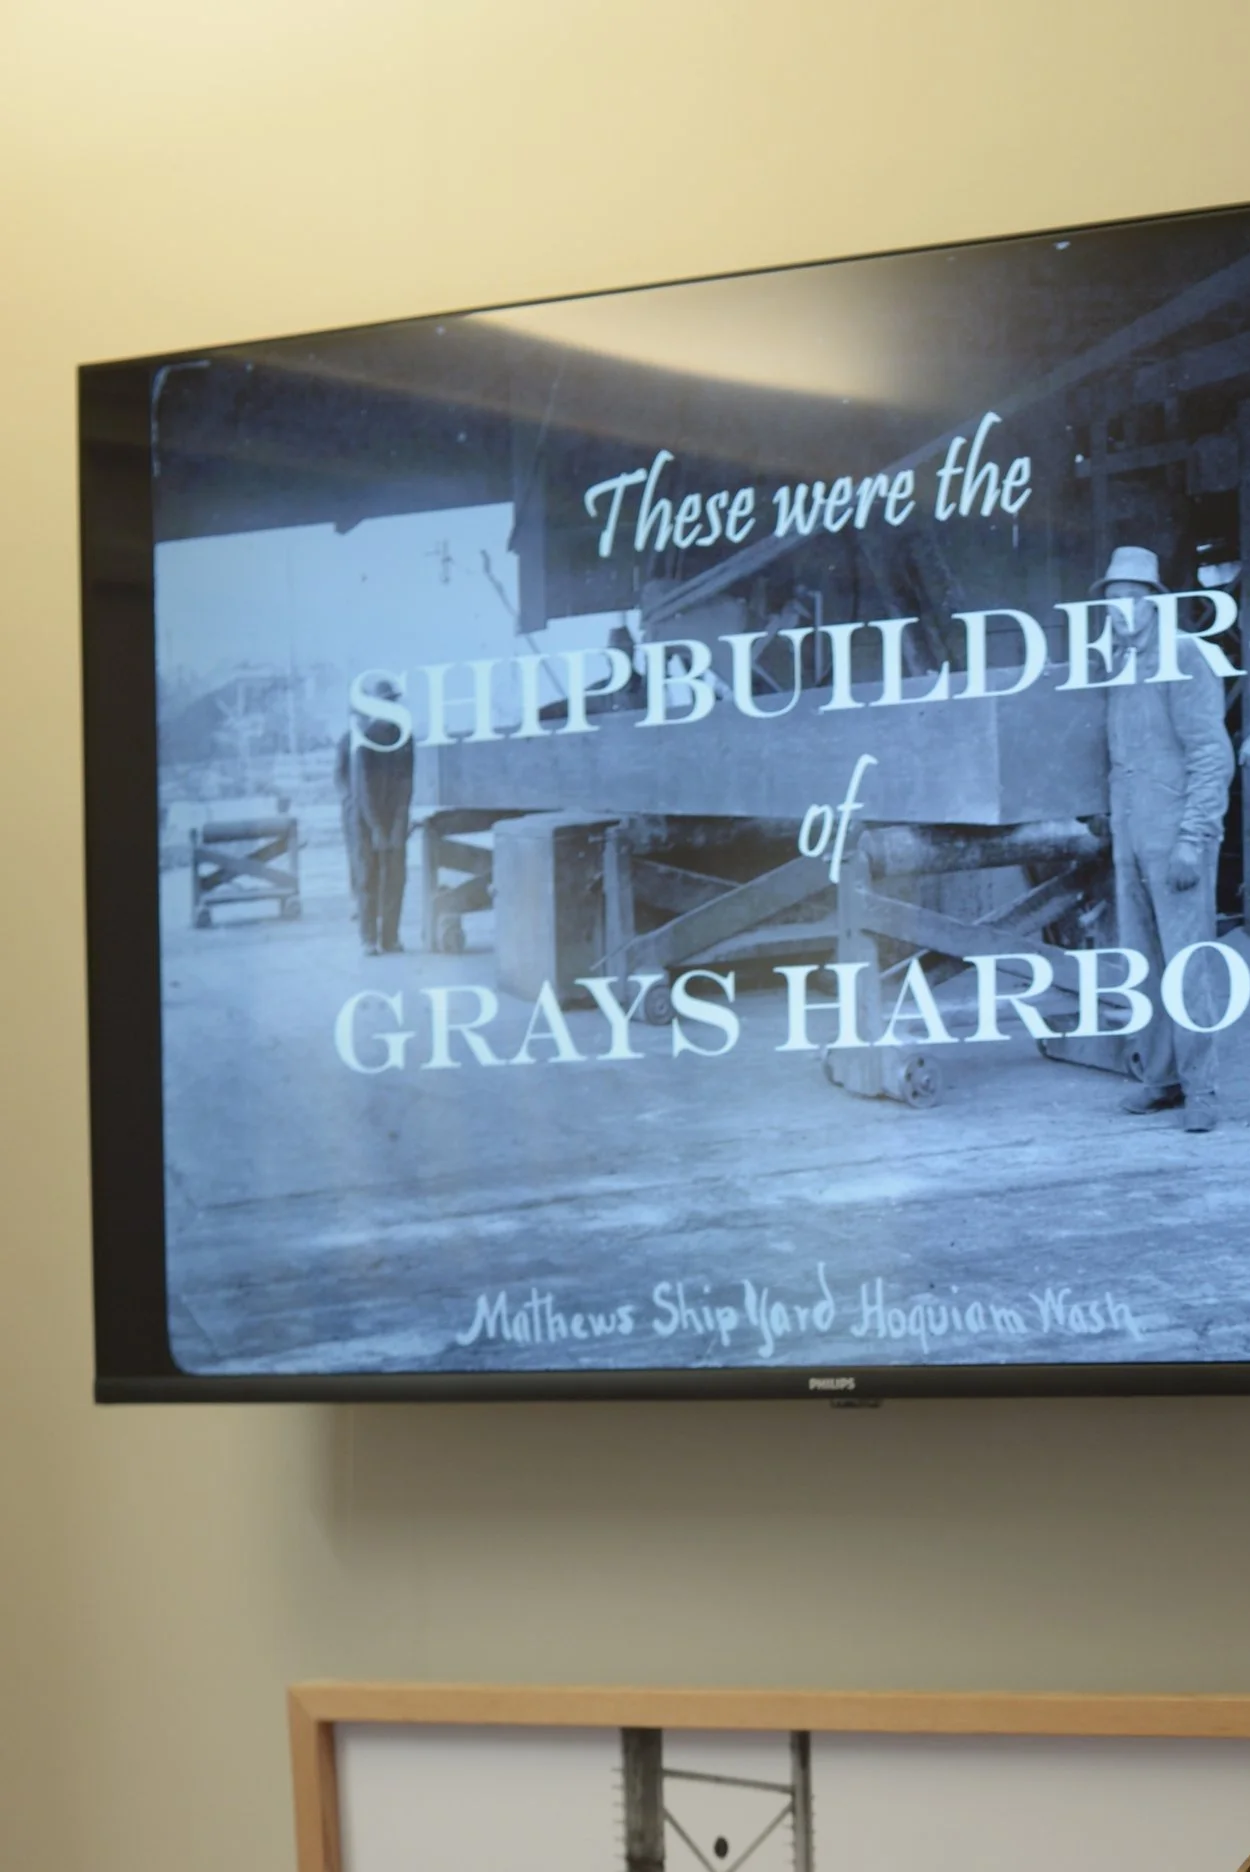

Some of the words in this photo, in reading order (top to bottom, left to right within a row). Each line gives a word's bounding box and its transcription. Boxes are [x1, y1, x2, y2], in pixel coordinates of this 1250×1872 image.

[584, 449, 755, 557] These
[772, 466, 915, 539] were
[934, 410, 1033, 521] the
[797, 752, 878, 884] of
[332, 967, 740, 1076] GRAYS
[456, 1286, 636, 1346] Mathews
[850, 1276, 1028, 1354] Hoquiam
[1028, 1287, 1148, 1342] Wash
[808, 1377, 856, 1391] PHILIPS
